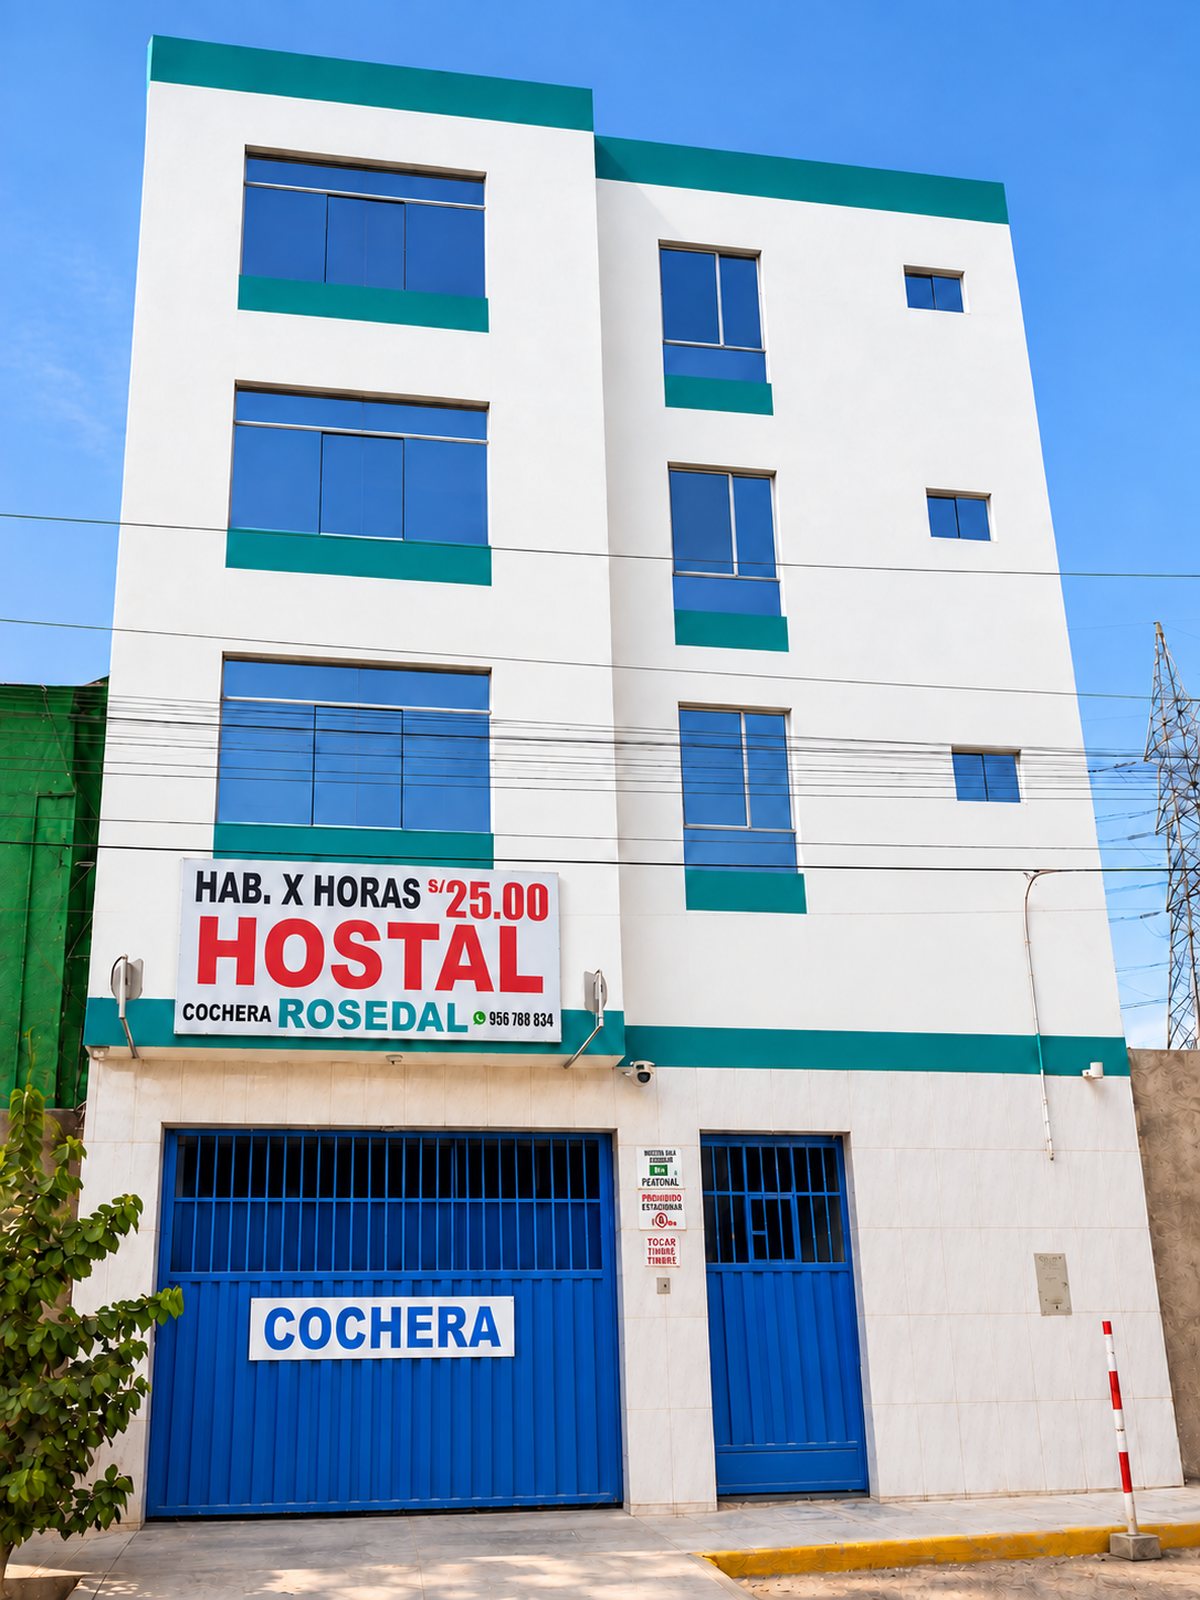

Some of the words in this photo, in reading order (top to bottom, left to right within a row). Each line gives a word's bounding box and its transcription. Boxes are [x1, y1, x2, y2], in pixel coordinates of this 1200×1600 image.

[195, 870, 271, 904] HAB.
[281, 873, 304, 905] X
[313, 874, 421, 909] HORAS
[197, 915, 544, 993] HOSTAL
[182, 1003, 272, 1022] COCHERA
[278, 998, 469, 1033] ROSEDAL
[489, 1011, 510, 1026] 956
[511, 1012, 531, 1027] 788
[533, 1012, 554, 1028] 834
[641, 1177, 680, 1187] PEATONAL
[647, 1237, 676, 1246] TOCAR
[264, 1306, 502, 1351] COCHERA
